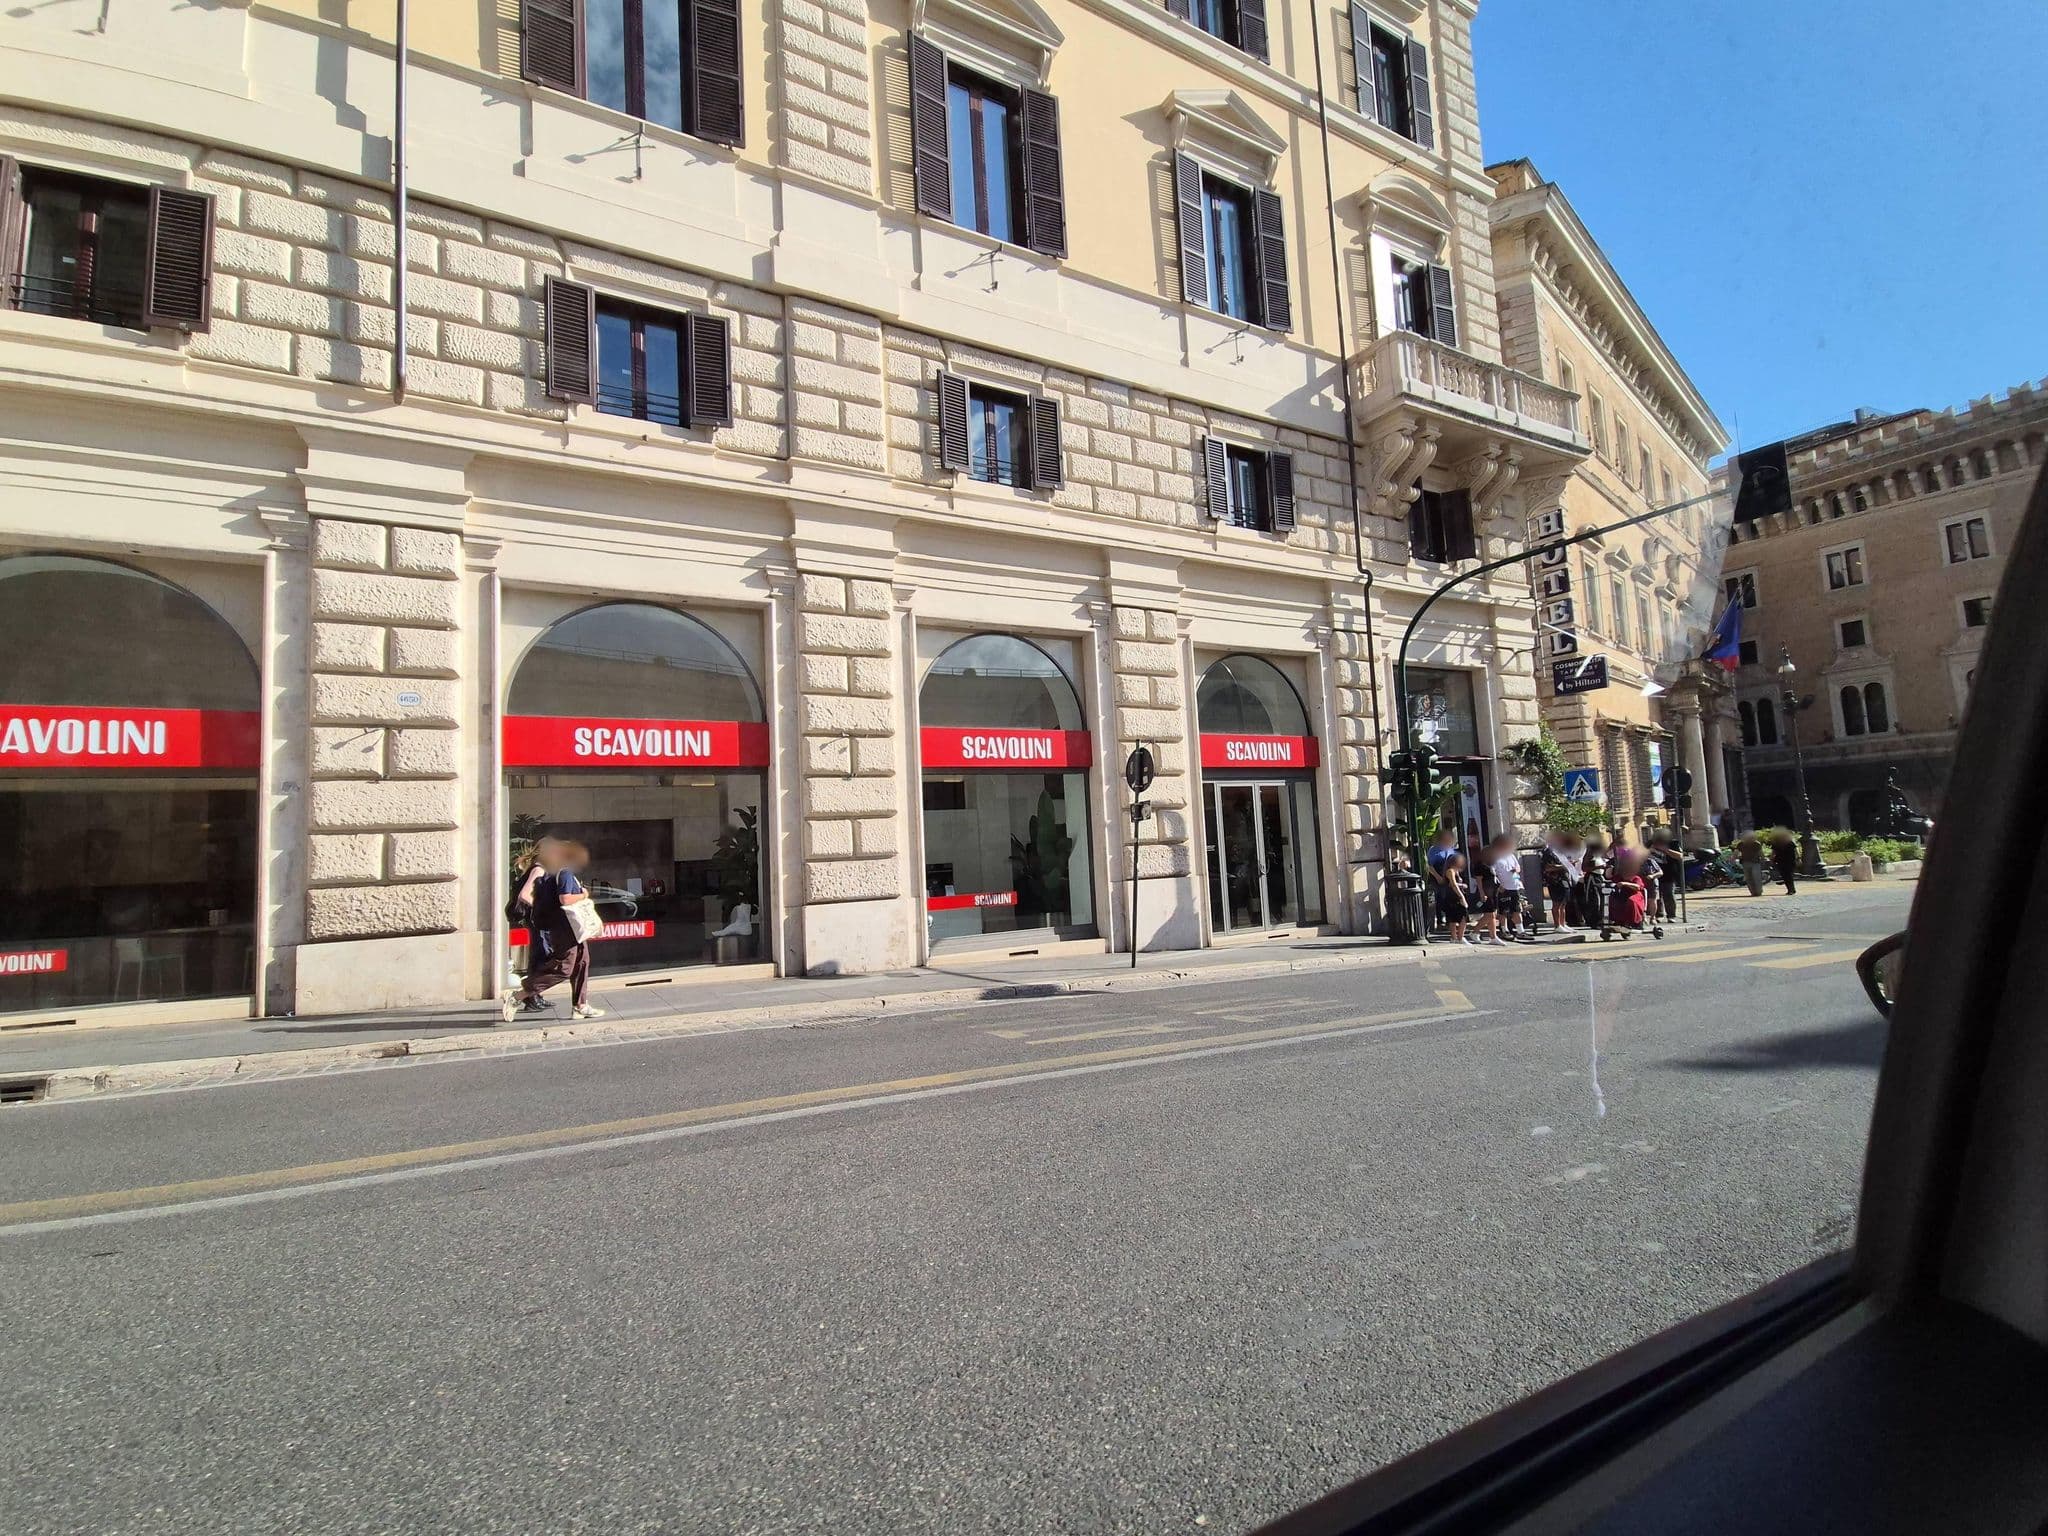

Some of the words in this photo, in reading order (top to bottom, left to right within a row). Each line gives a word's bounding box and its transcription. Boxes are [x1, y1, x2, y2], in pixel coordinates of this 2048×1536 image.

[1538, 509, 1573, 655] HOTEL
[1575, 678, 1601, 687] Hilton
[0, 718, 166, 755] AVOLINI
[574, 727, 711, 757] SCAVOLINI
[962, 736, 1053, 759] SCAVOLINI
[1226, 741, 1291, 761] SCAVOLINI
[974, 893, 1012, 906] SCAVOLINI
